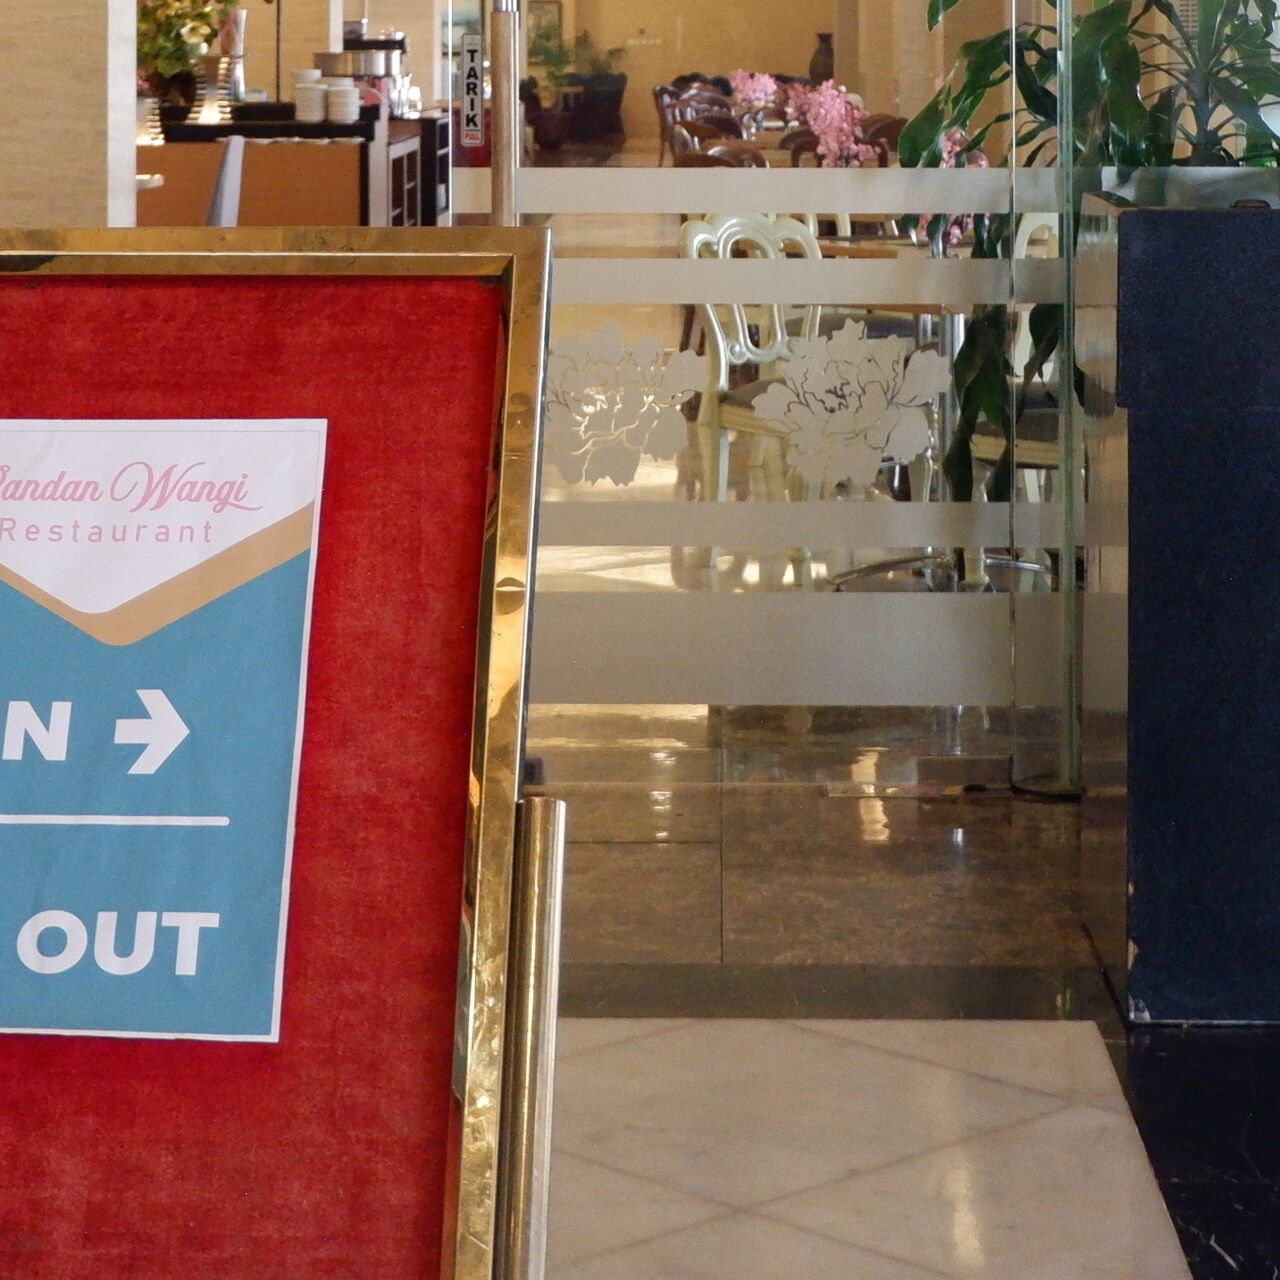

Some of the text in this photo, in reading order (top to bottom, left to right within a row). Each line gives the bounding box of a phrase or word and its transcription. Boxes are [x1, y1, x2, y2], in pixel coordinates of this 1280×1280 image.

[465, 48, 479, 128] TARIK
[464, 132, 480, 141] PULL
[109, 461, 265, 513] Wangi
[16, 909, 220, 976] OUT
